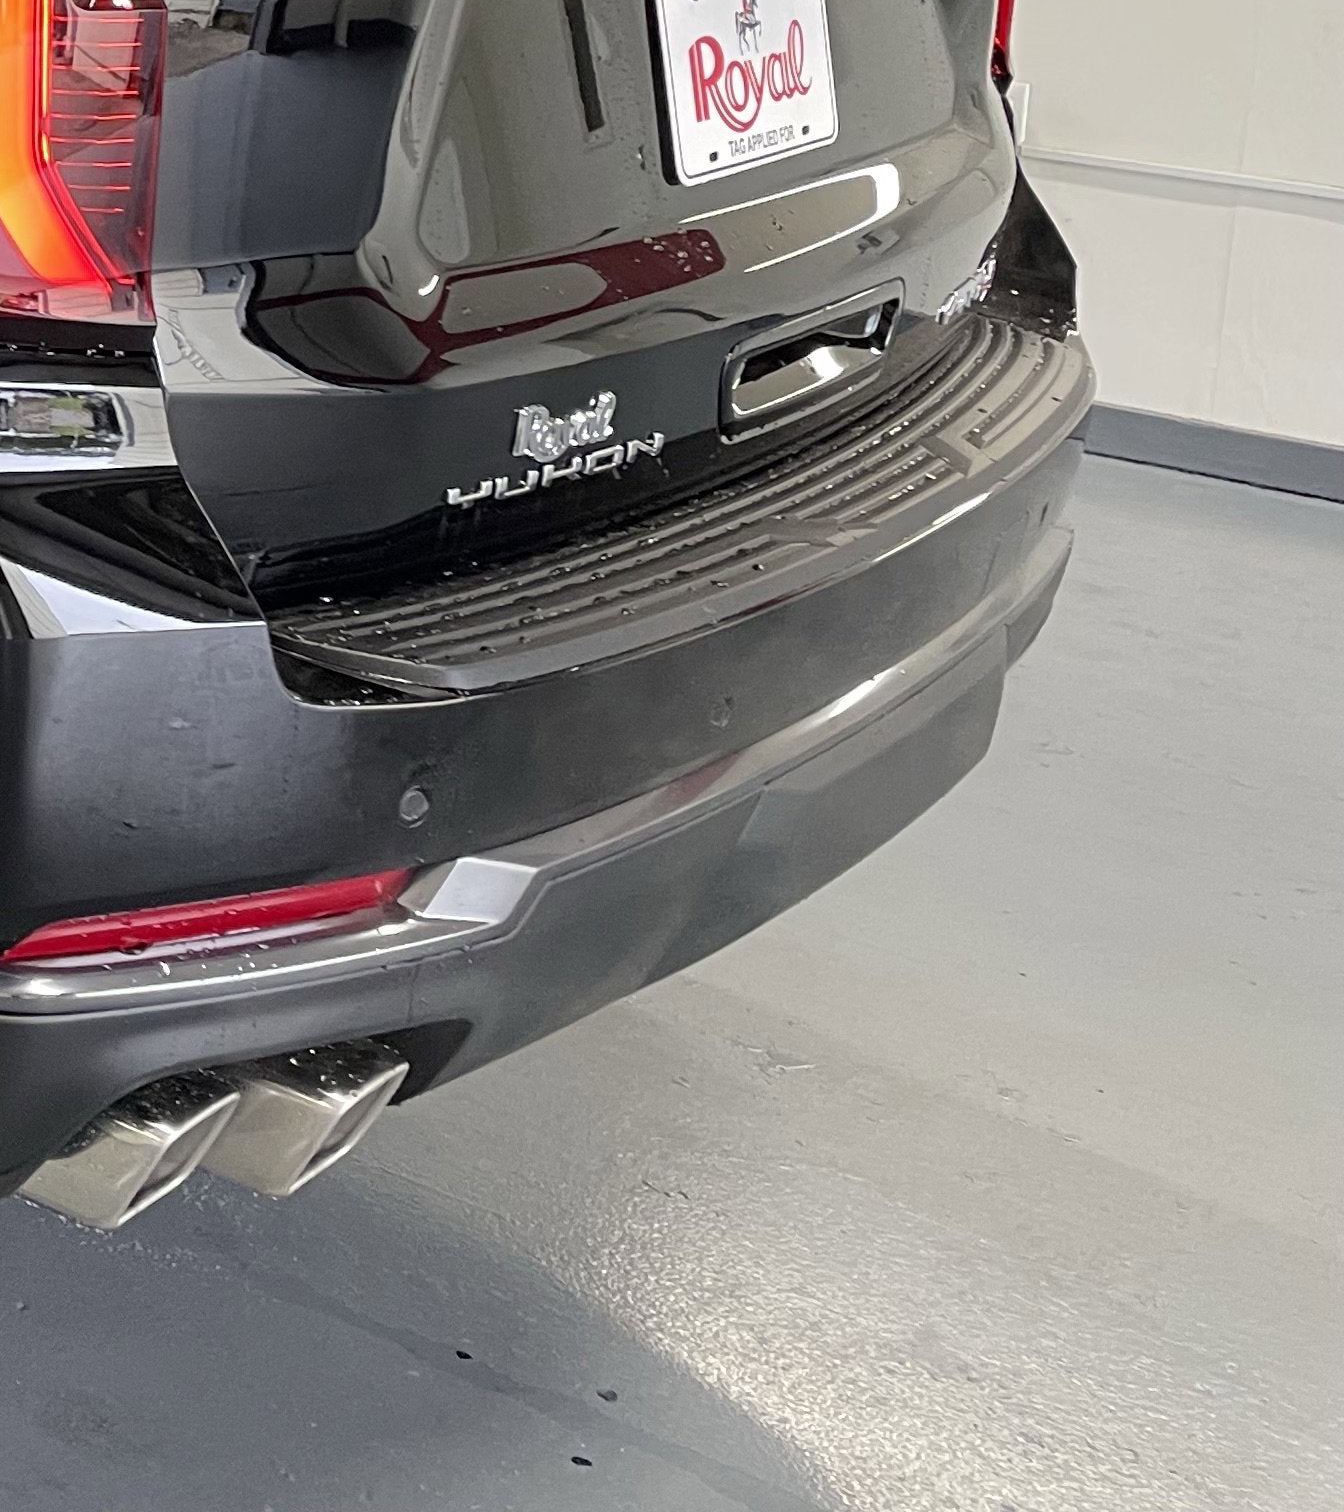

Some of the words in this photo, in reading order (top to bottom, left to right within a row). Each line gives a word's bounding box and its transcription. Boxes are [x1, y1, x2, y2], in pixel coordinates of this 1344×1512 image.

[688, 19, 812, 132] Royal
[728, 137, 746, 157] TAG
[747, 129, 778, 152] APPLIED
[779, 125, 796, 142] FOR
